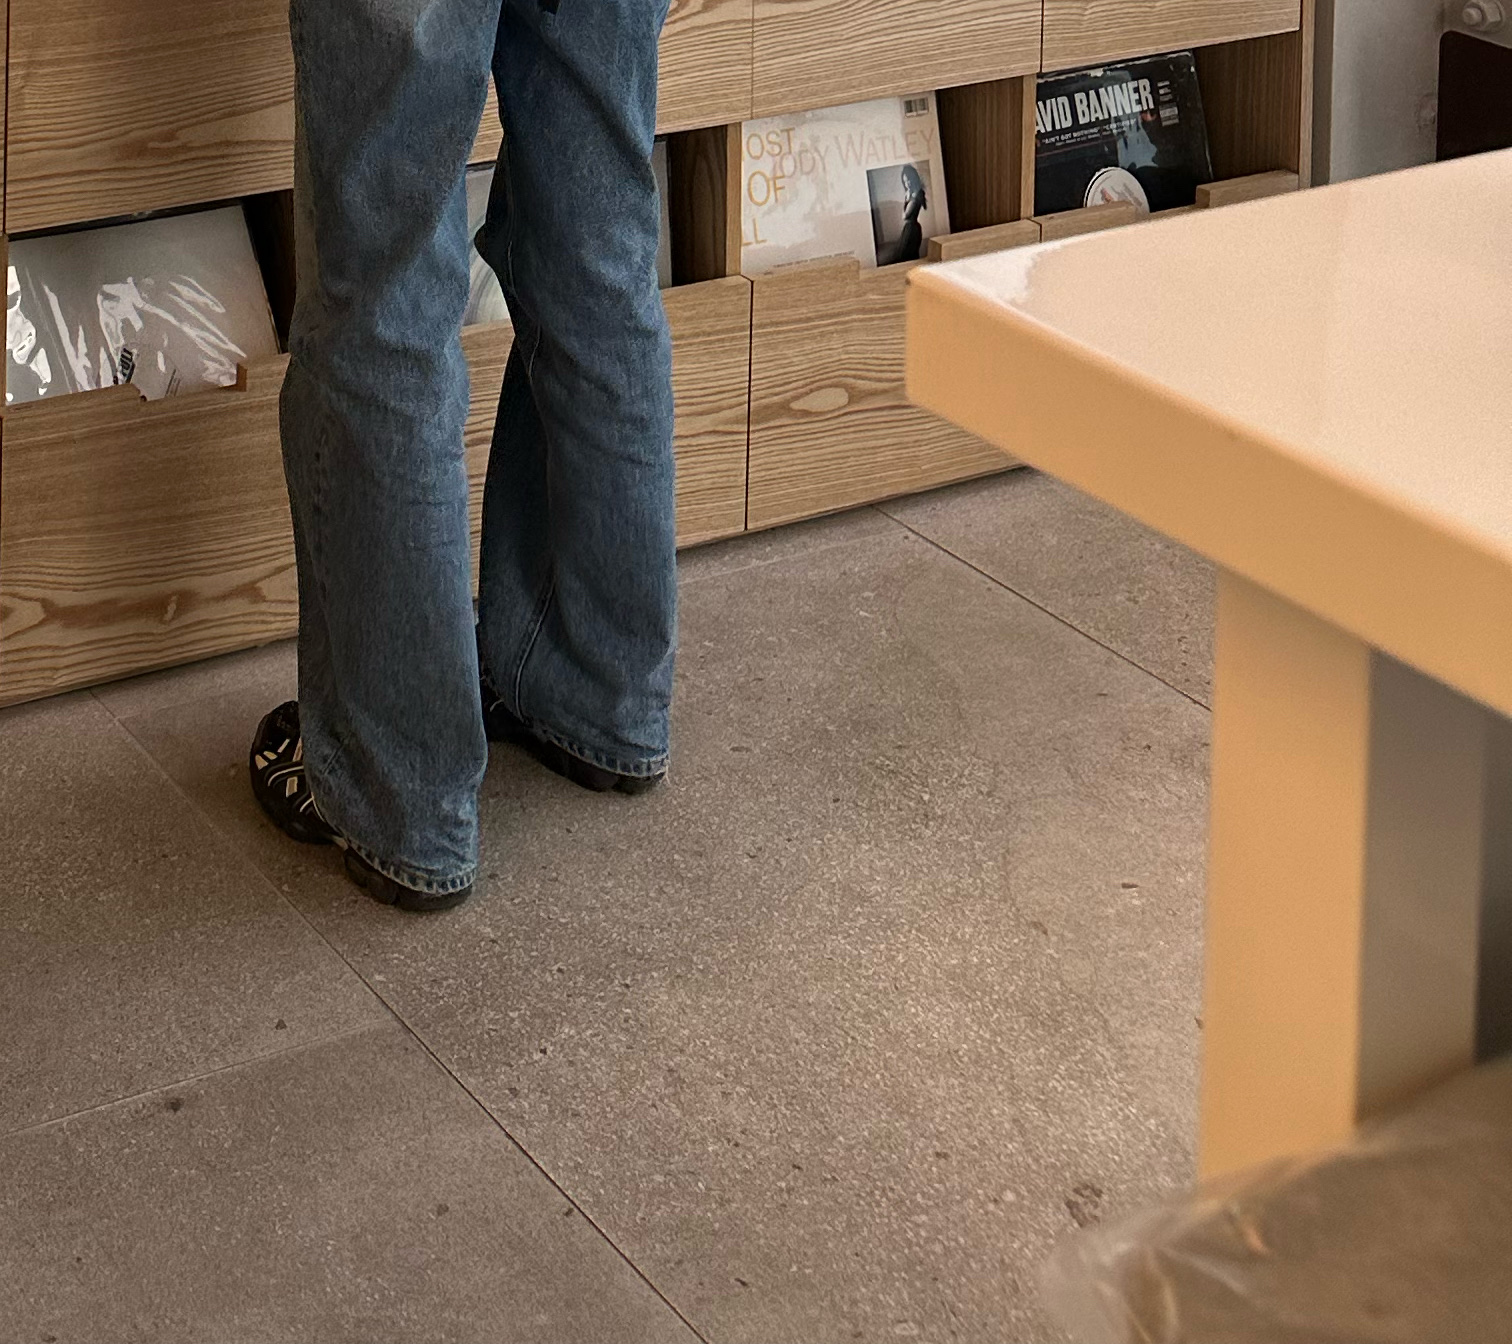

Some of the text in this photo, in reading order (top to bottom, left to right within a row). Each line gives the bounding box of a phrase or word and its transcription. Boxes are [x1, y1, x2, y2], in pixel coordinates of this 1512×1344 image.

[1036, 96, 1073, 133] AVID
[1074, 78, 1155, 125] BANNER
[744, 127, 796, 161] OST
[835, 127, 935, 169] WATLEY
[748, 170, 786, 207] OF
